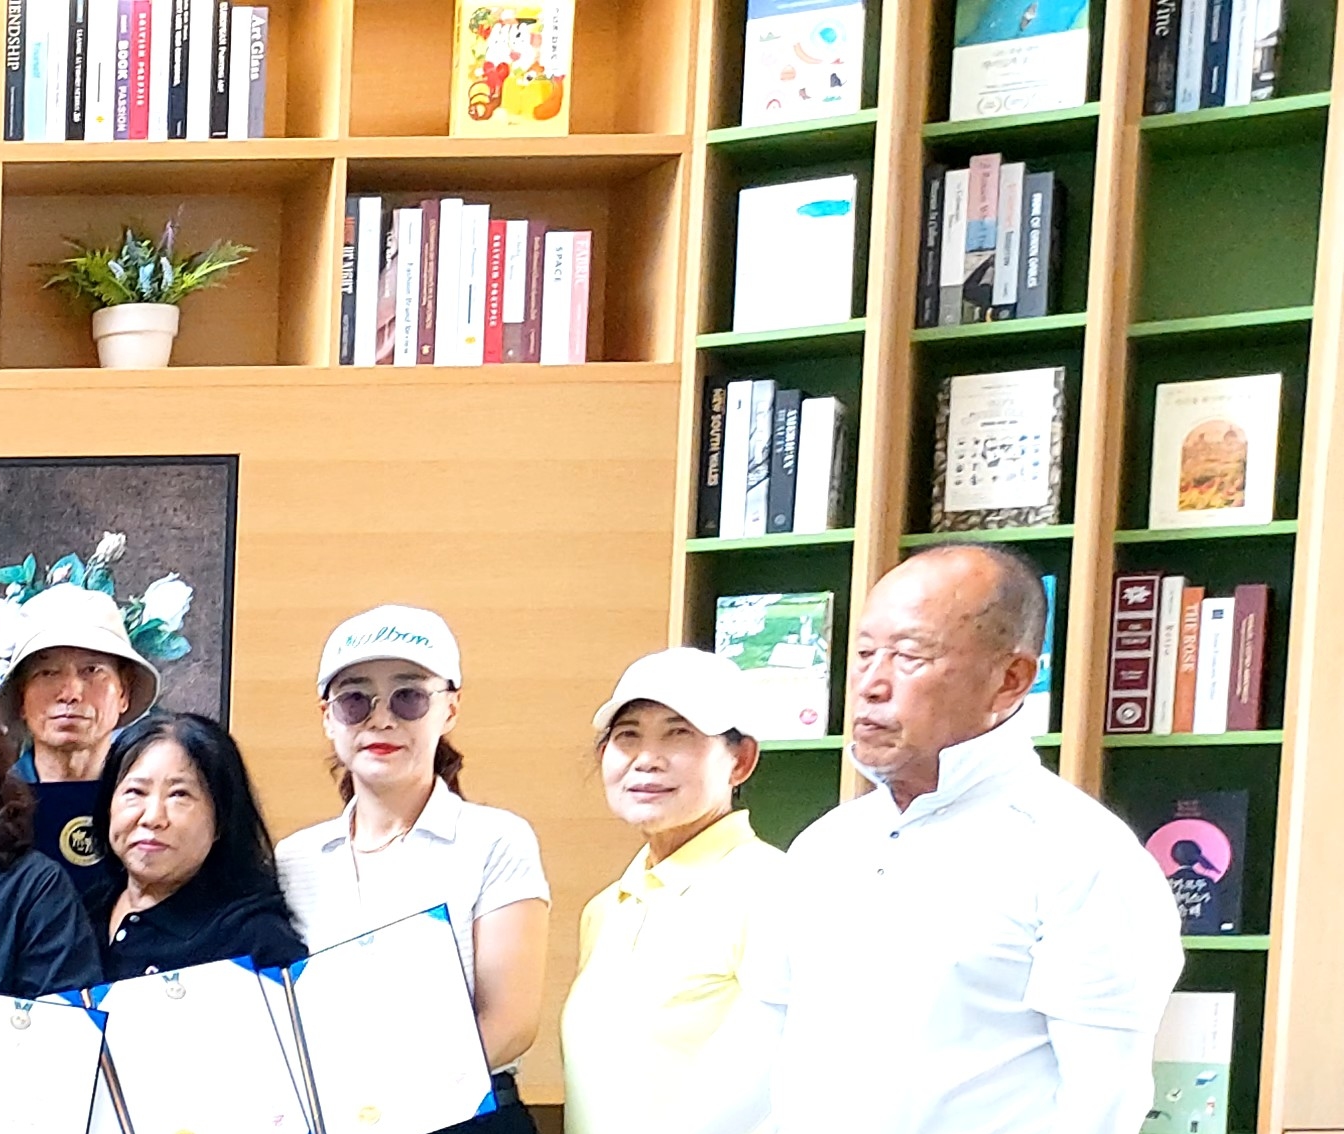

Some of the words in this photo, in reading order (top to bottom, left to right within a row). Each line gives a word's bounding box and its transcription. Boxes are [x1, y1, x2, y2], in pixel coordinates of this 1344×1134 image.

[251, 15, 265, 40] Art
[117, 40, 128, 80] BOOK
[250, 41, 264, 81] Glass
[117, 85, 127, 131] PASSION
[554, 247, 563, 282] SPACE
[712, 388, 725, 412] NEW
[709, 415, 722, 451] SOUTH
[1184, 602, 1199, 633] THE
[1181, 635, 1197, 673] ROSE
